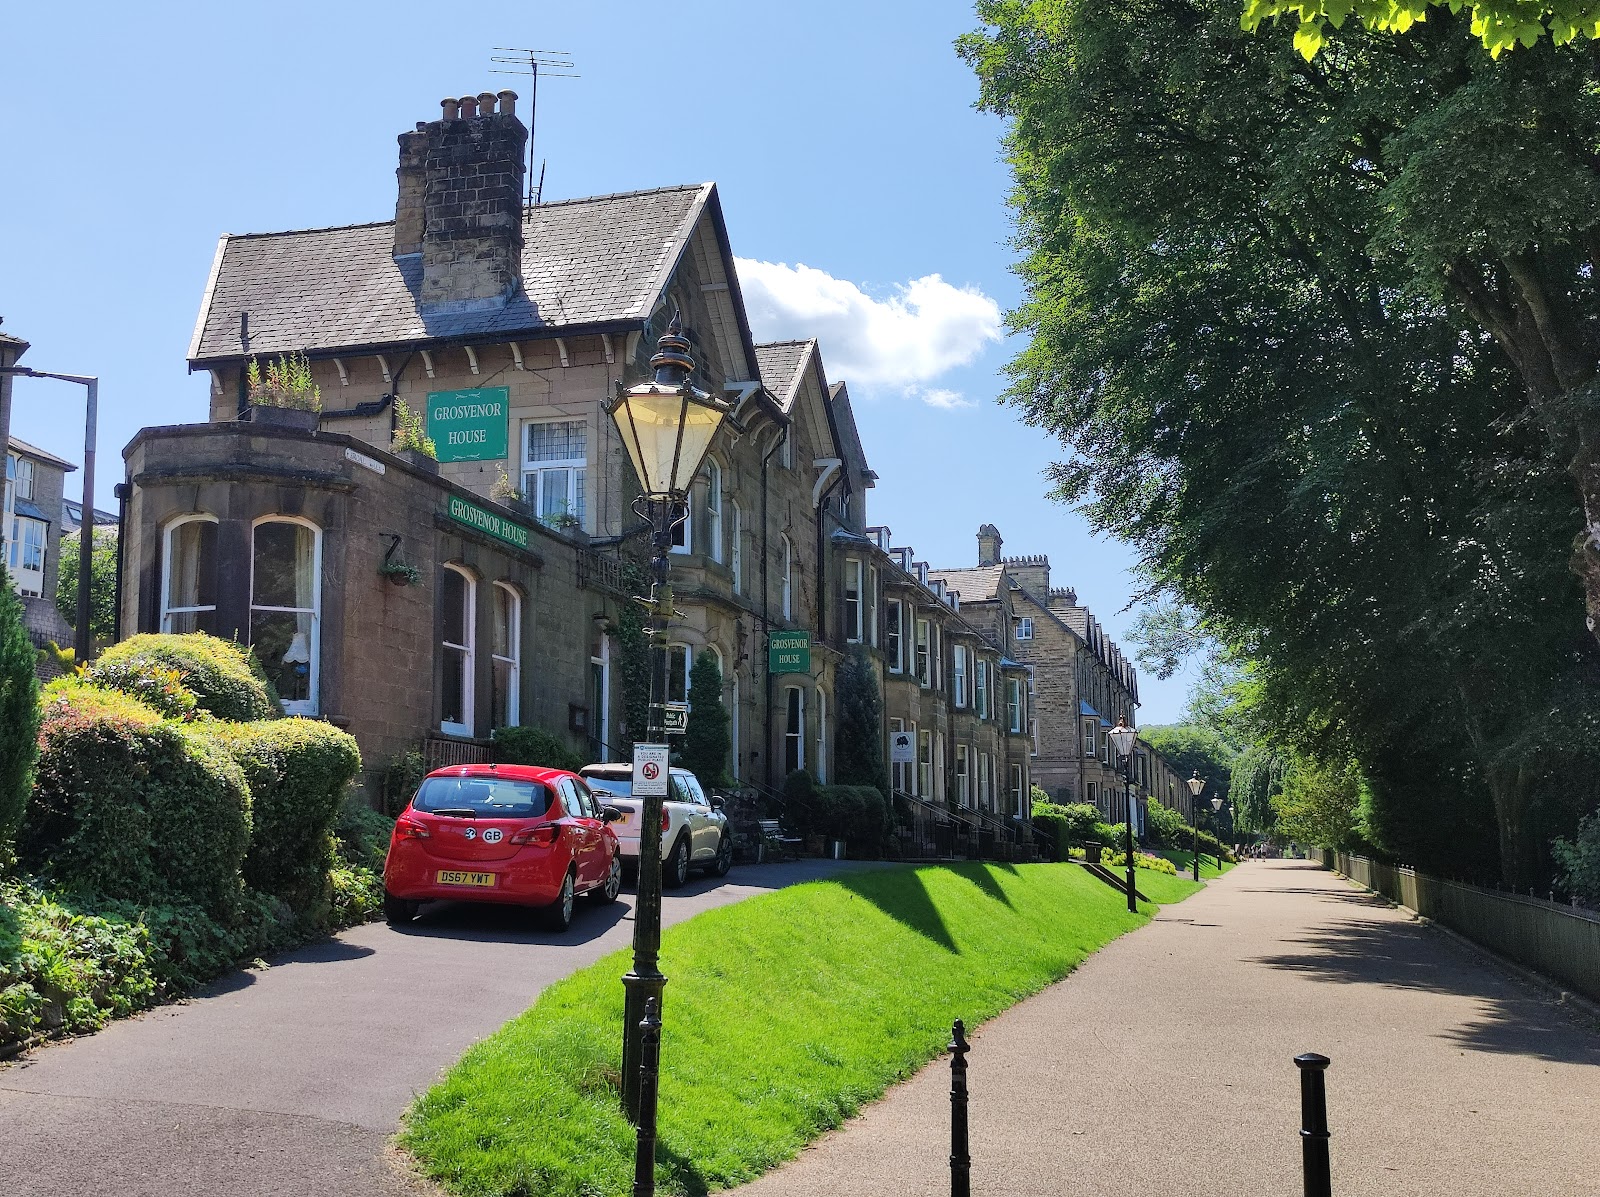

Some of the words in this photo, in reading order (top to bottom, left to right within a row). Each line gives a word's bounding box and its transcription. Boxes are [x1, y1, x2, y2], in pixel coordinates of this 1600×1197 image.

[434, 403, 501, 420] GROSVENOR
[448, 429, 487, 445] HOUSE
[451, 499, 500, 535] GROSVENOR
[502, 521, 527, 546] HOUSE
[771, 639, 808, 649] GROSVENOR
[779, 654, 800, 664] HOUSE
[484, 831, 501, 841] GB
[441, 872, 468, 882] DS67
[471, 873, 490, 884] YWT
